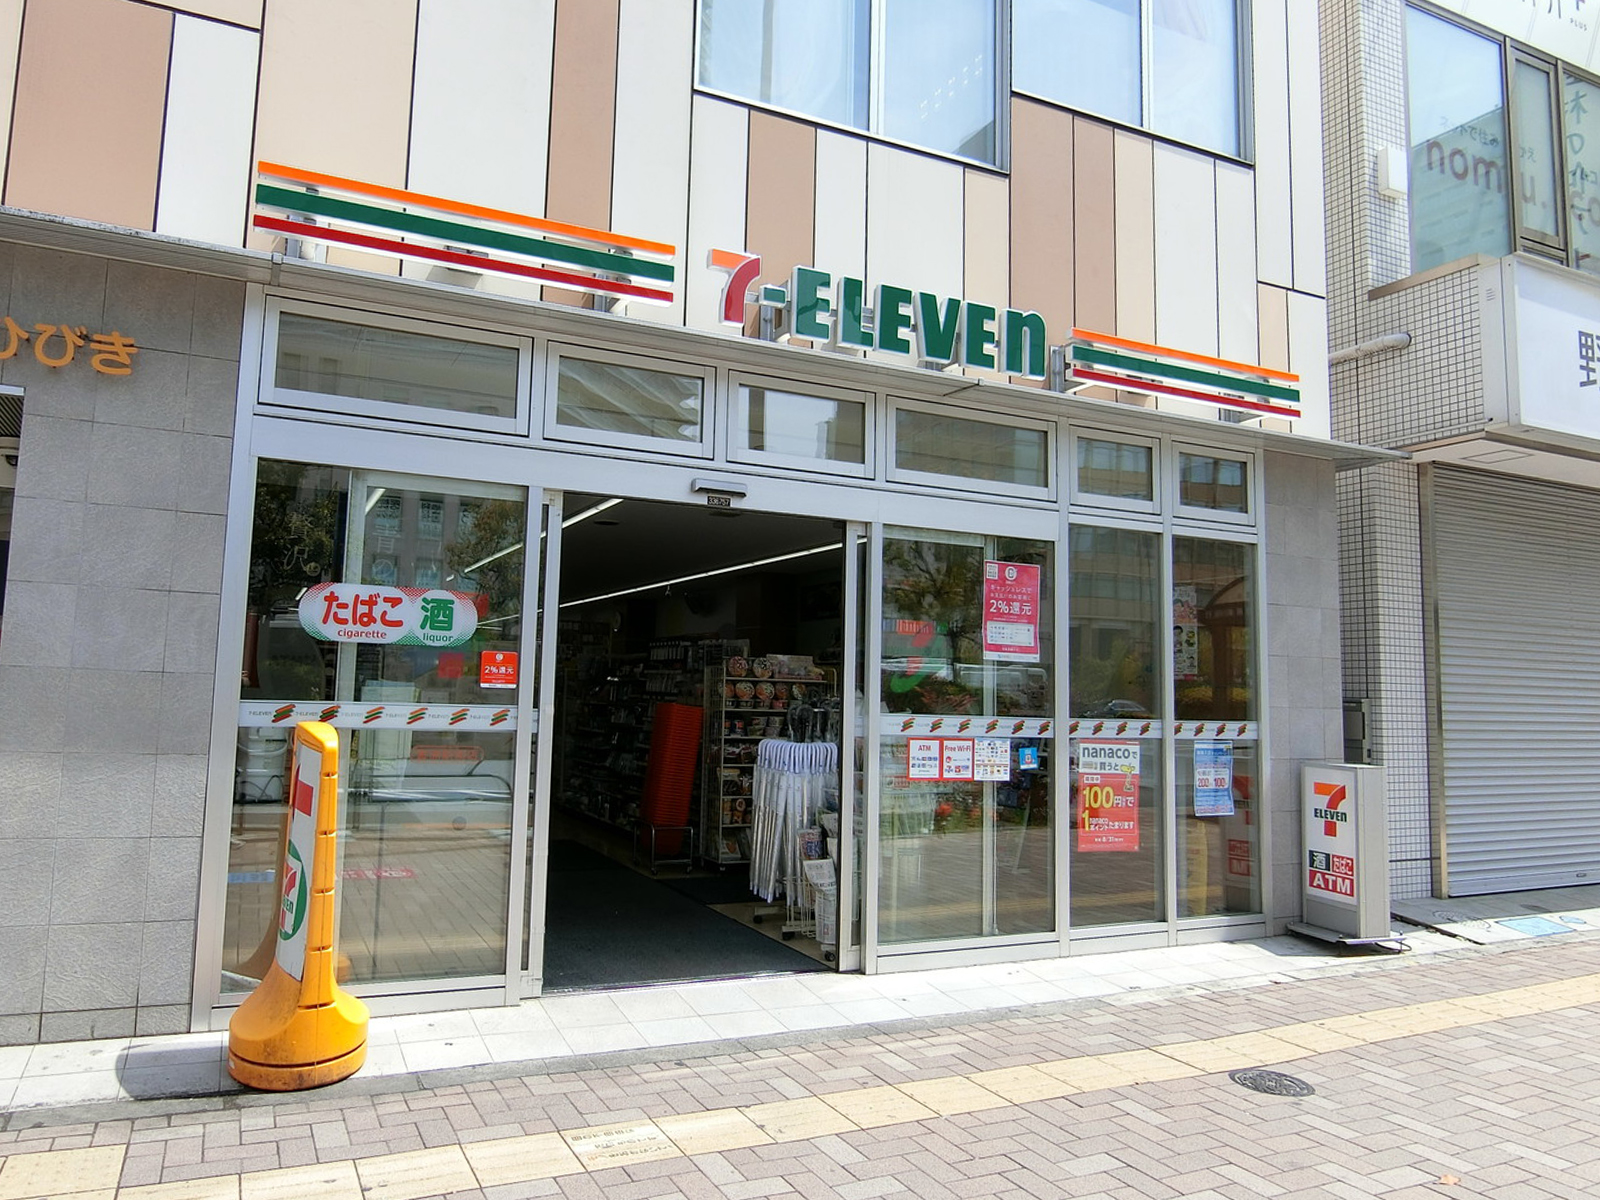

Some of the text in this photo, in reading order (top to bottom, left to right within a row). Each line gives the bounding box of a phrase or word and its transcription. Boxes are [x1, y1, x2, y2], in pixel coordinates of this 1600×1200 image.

[322, 591, 455, 631] たばこ 酒
[989, 600, 1032, 616] 2%還元
[337, 629, 454, 642] cigarette liquor
[917, 744, 932, 752] ATM
[944, 744, 957, 752] Free
[1312, 852, 1327, 869] 酒
[1312, 871, 1352, 894] ATM
